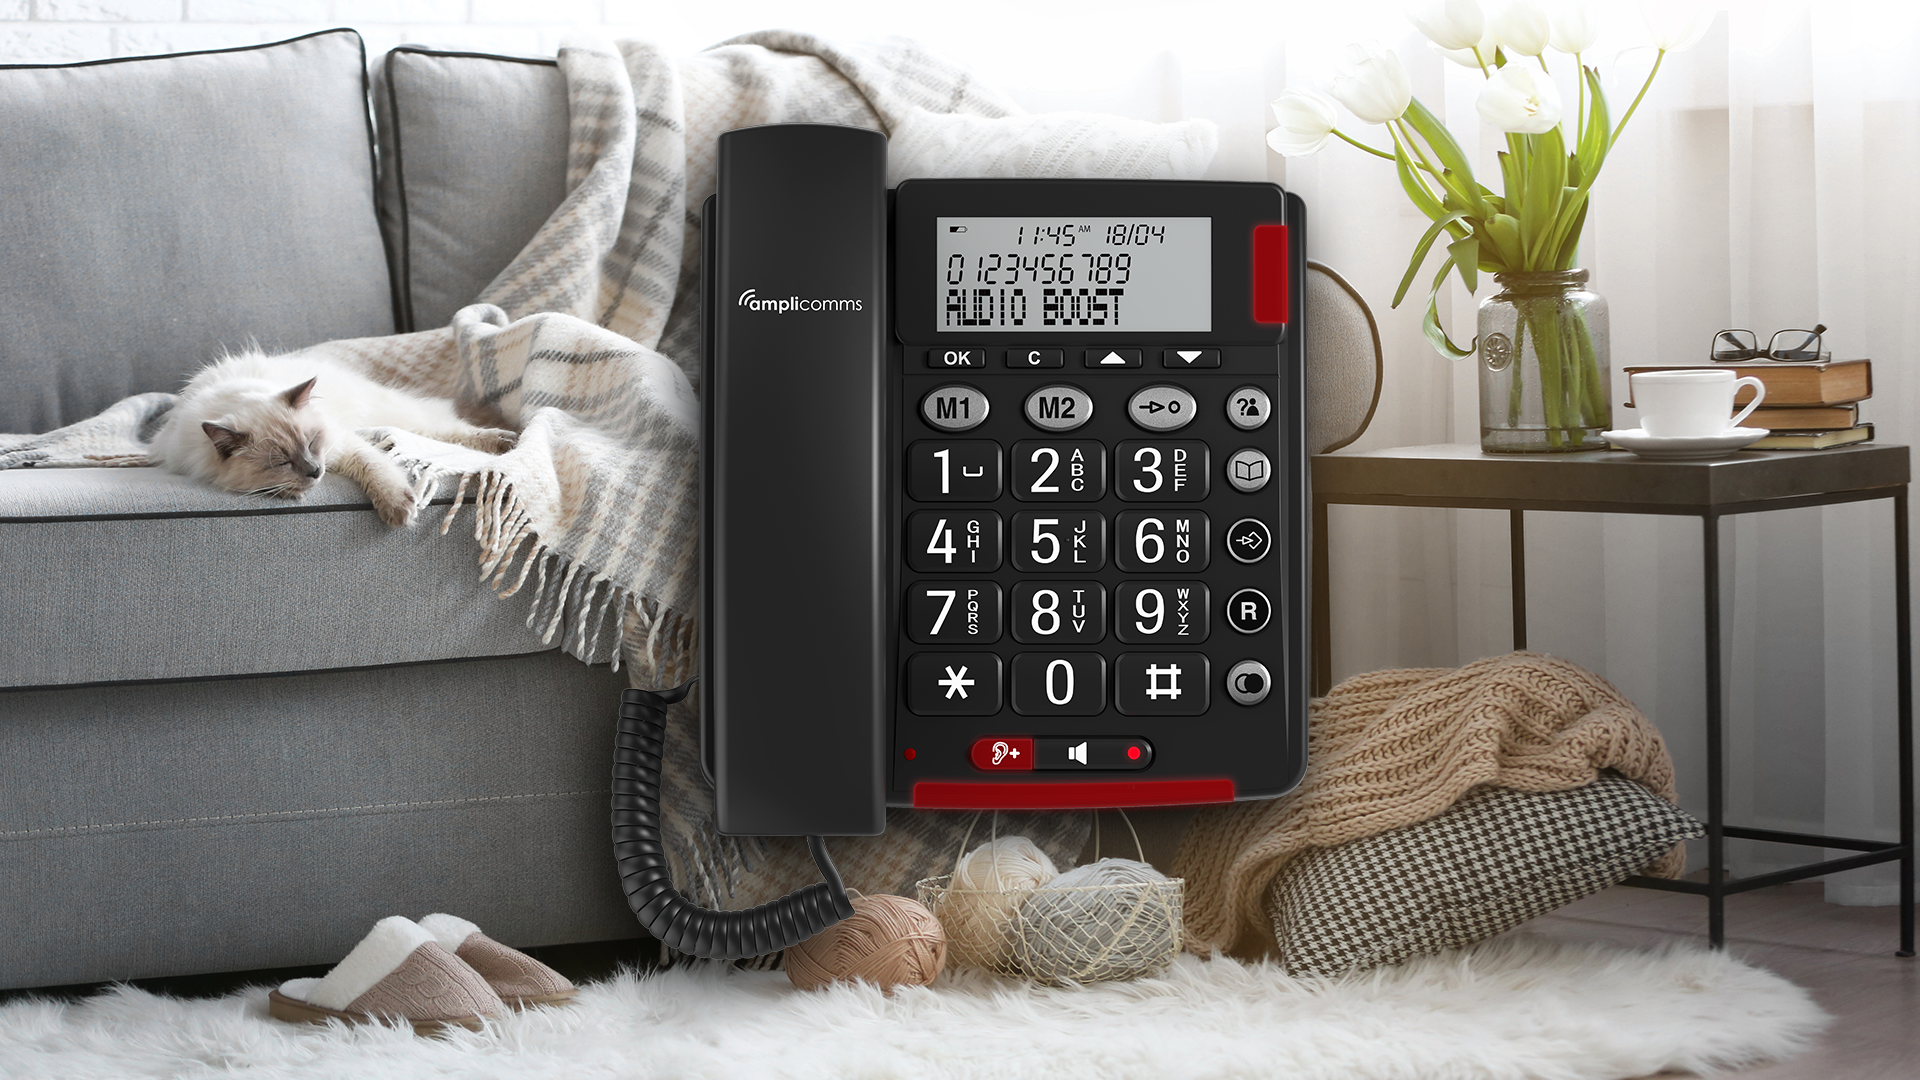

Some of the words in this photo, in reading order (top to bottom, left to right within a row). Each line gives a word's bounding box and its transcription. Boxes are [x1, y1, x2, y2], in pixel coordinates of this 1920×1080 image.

[1019, 225, 1075, 246] 11:45
[1078, 225, 1091, 233] AM
[1107, 224, 1164, 245] 18/04
[748, 295, 863, 315] amplicomms
[947, 289, 1026, 326] AUDIO
[1044, 289, 1123, 325] BOOST
[944, 351, 970, 365] OK
[1029, 351, 1040, 364] C
[937, 397, 969, 419] M1
[1038, 397, 1075, 419] M2
[934, 449, 949, 493] 1
[1031, 448, 1059, 492] 2
[1134, 448, 1162, 492] 3
[927, 519, 956, 563] 4
[1032, 519, 1059, 563] 5
[1136, 518, 1164, 563] 6
[927, 591, 955, 634] 7
[1032, 590, 1060, 634] 8
[1136, 589, 1164, 634] 9
[1242, 602, 1256, 620] R
[1046, 660, 1074, 704] 0
